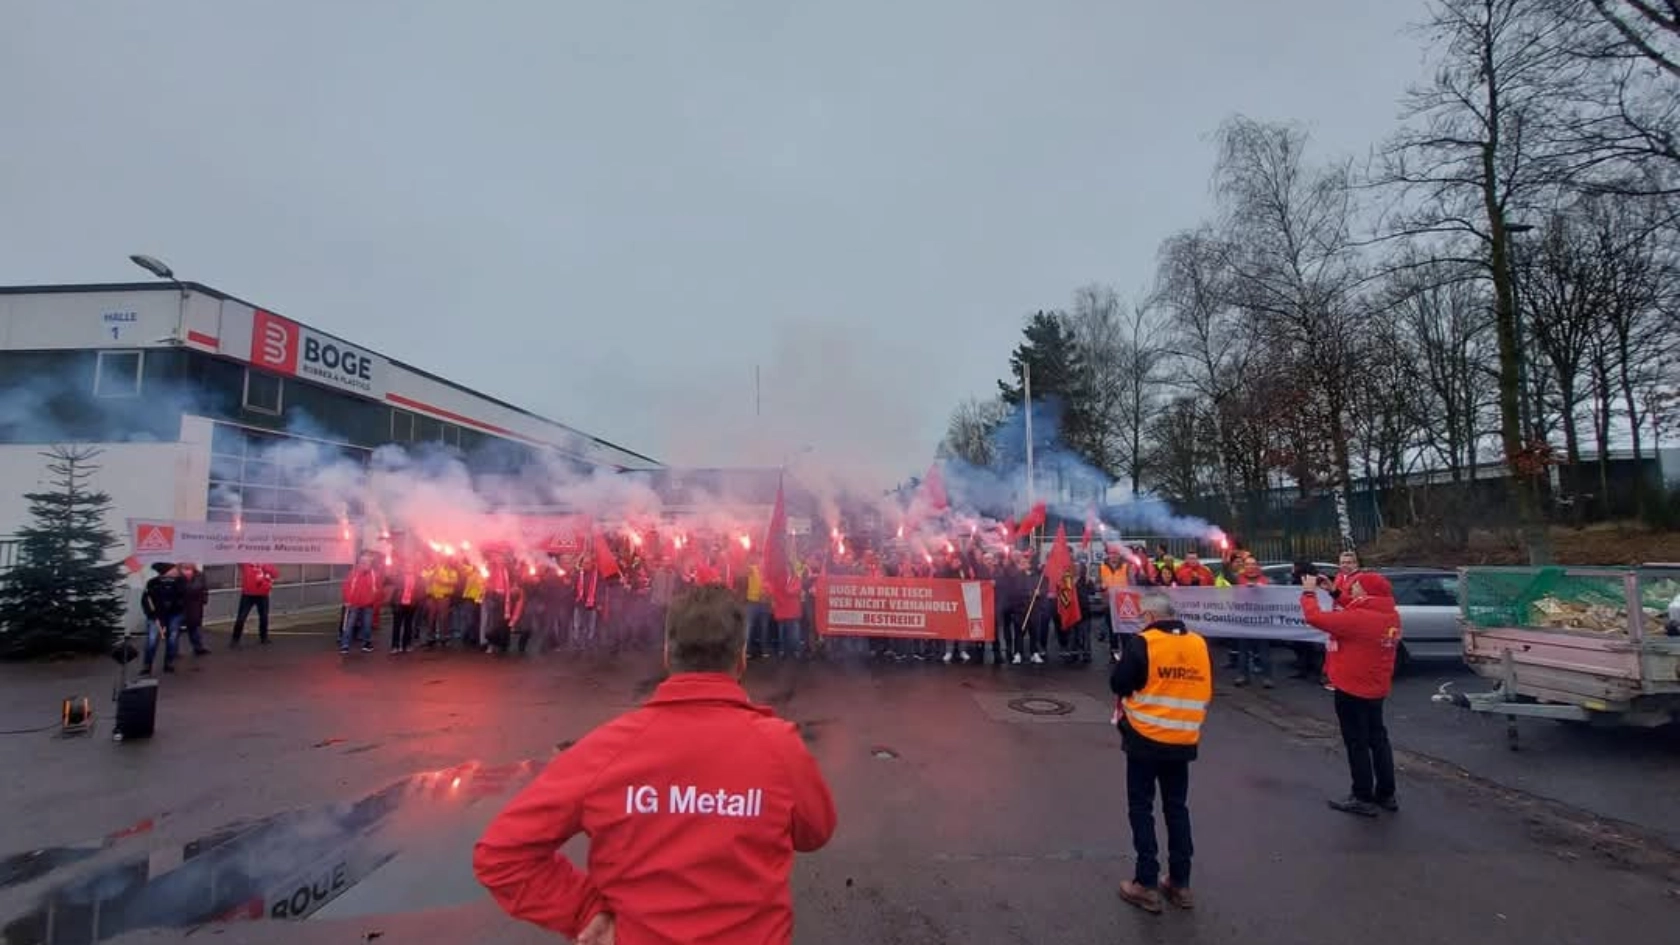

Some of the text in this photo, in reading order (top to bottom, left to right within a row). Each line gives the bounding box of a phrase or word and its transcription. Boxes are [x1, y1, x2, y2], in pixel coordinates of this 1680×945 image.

[104, 312, 137, 322] HALLE
[111, 327, 119, 339] 1
[304, 336, 371, 380] BOGE
[901, 587, 933, 598] TISCH
[854, 598, 886, 610] NICHT
[889, 600, 959, 612] VERHANDELT
[1203, 612, 1273, 626] Continental
[1157, 667, 1186, 679] WIR
[626, 785, 762, 817] IG Metall
